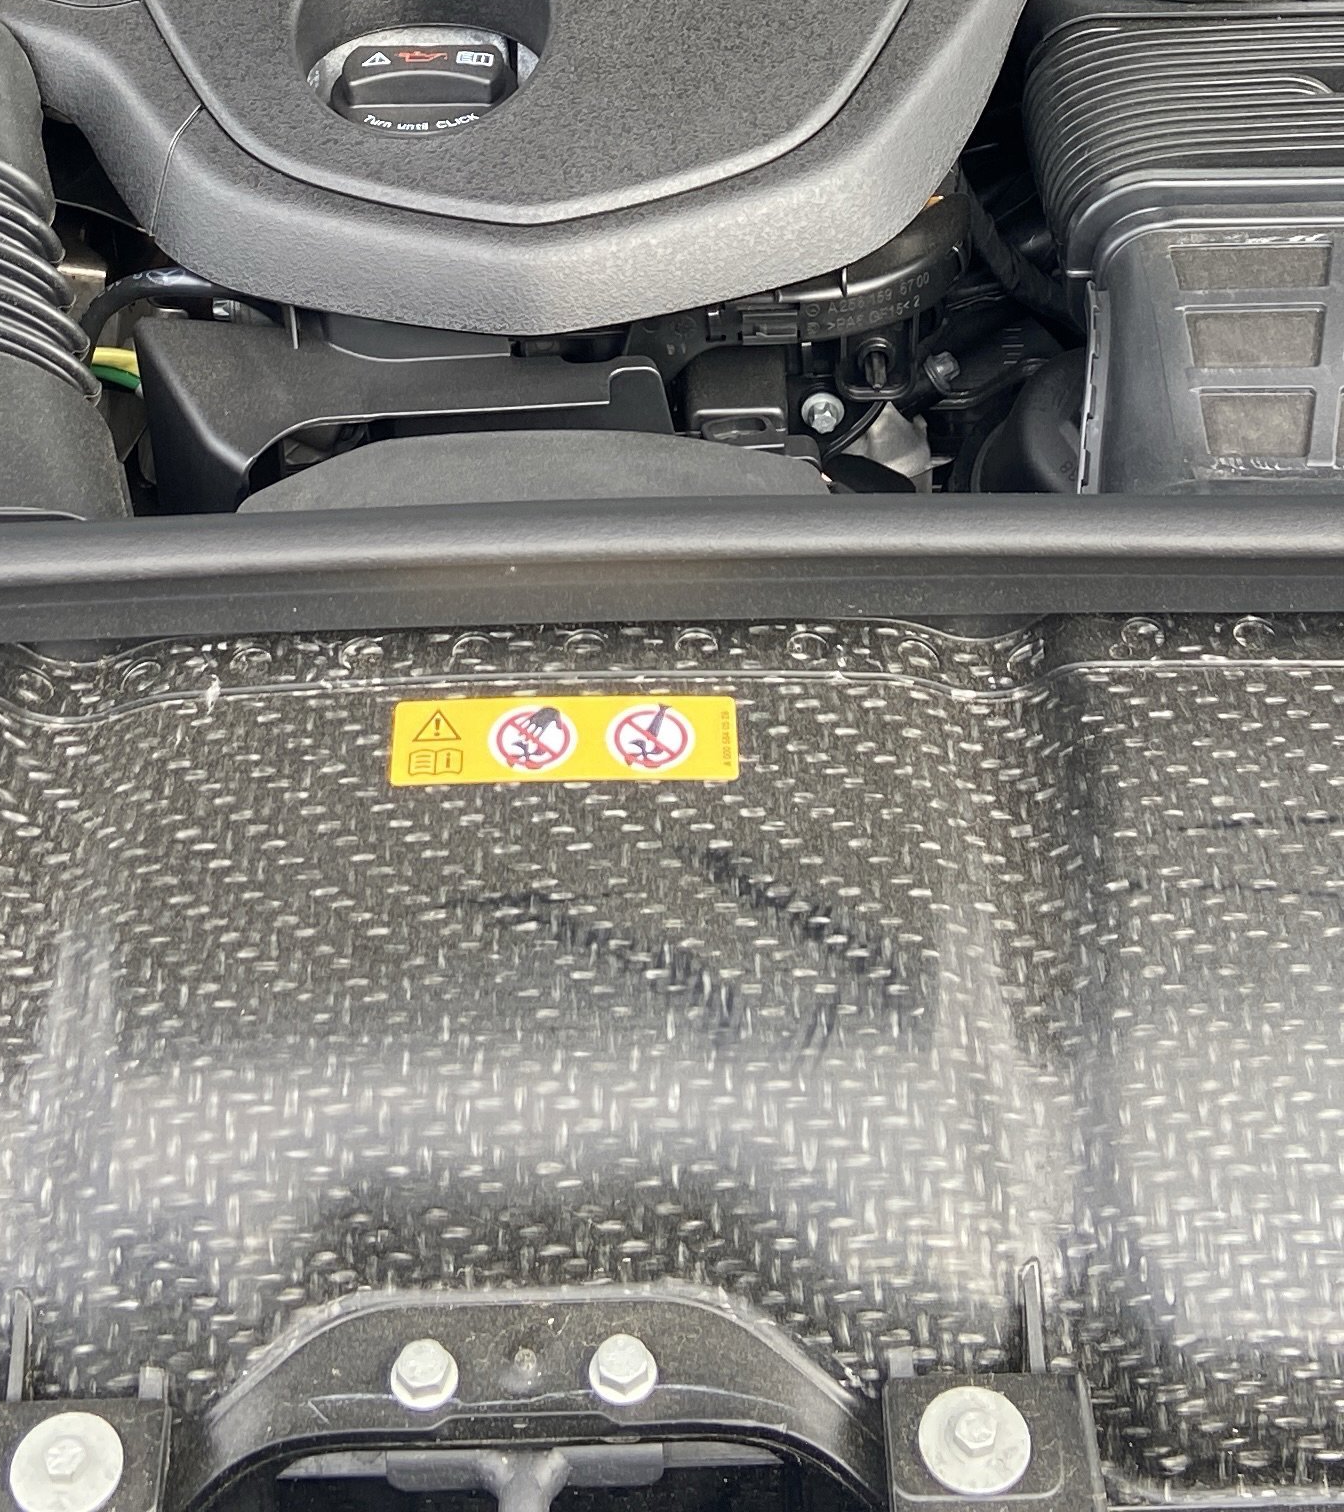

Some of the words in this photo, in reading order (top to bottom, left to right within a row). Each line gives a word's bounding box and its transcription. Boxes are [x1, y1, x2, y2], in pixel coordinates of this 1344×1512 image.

[363, 114, 392, 129] Turn
[397, 122, 429, 131] until
[436, 113, 480, 129] CLICK
